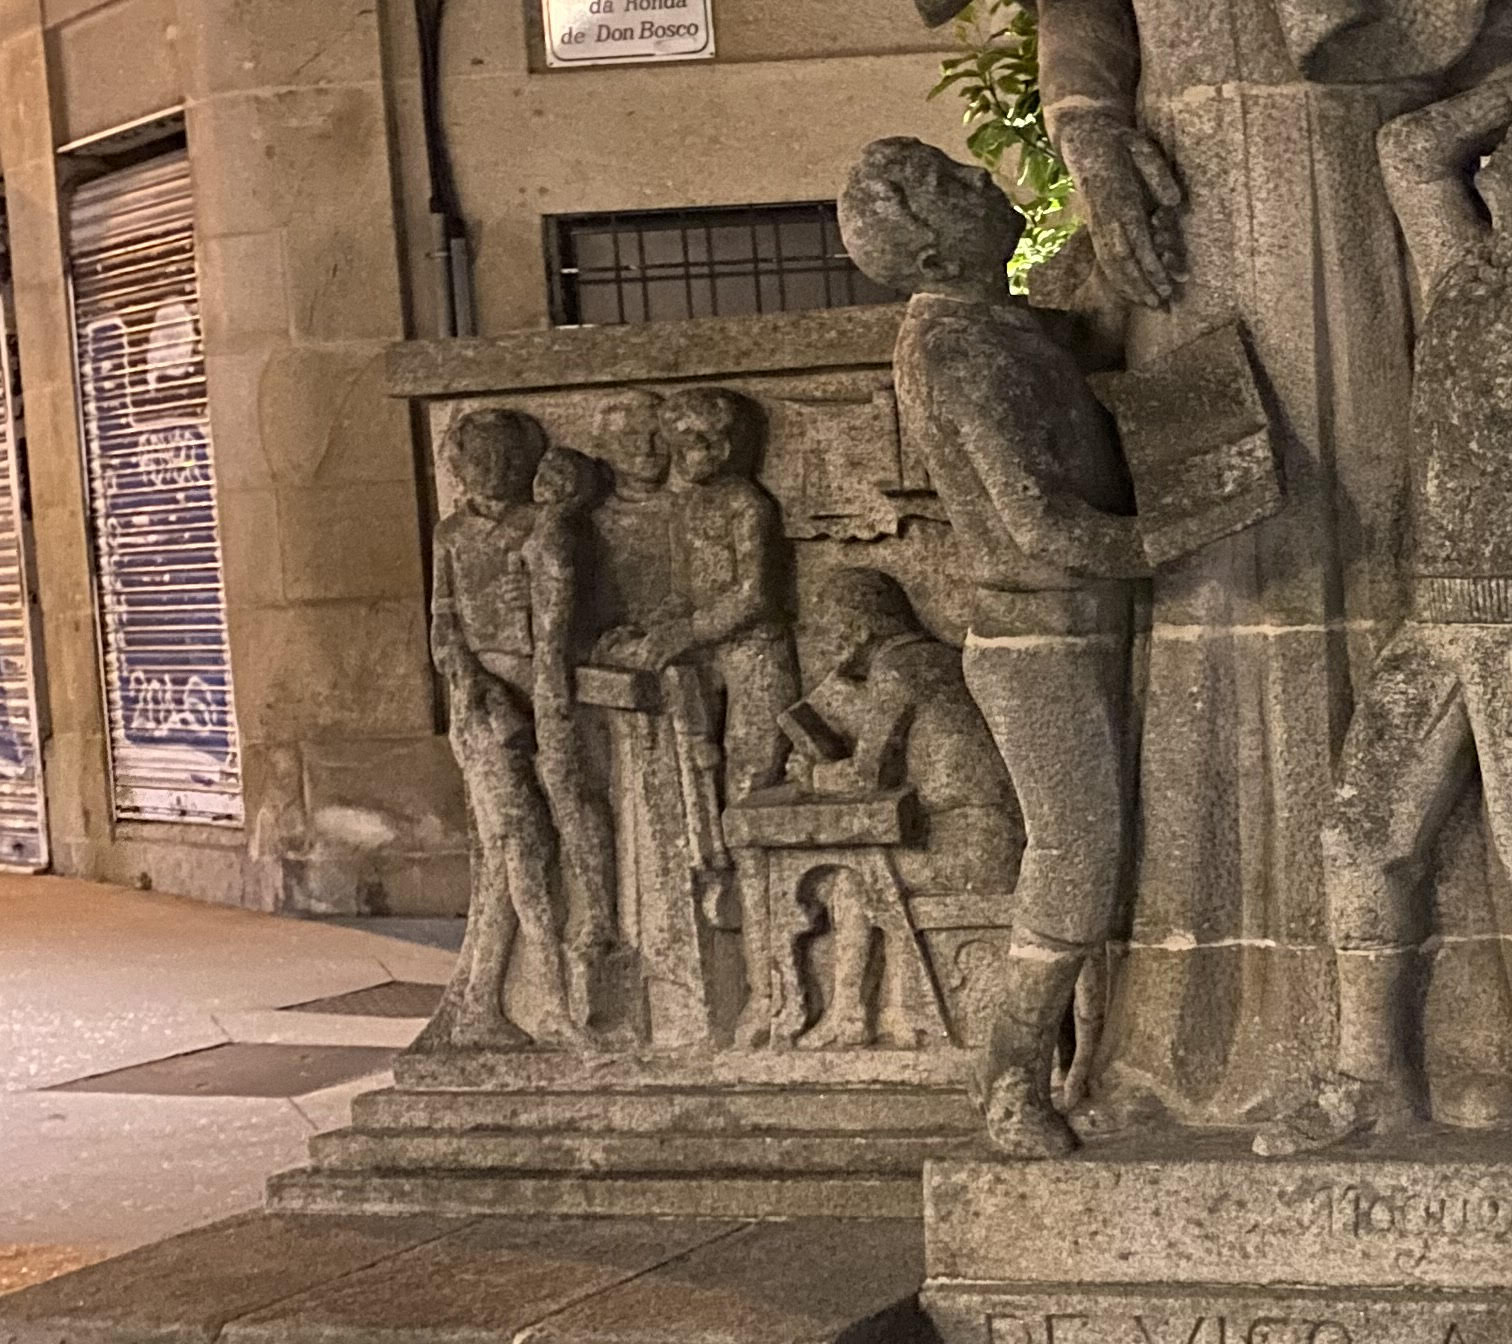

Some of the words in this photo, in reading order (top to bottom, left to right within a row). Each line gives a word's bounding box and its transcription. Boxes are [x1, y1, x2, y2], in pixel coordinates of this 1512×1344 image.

[561, 26, 586, 45] de
[595, 24, 634, 43] Don
[639, 20, 699, 40] Bosco
